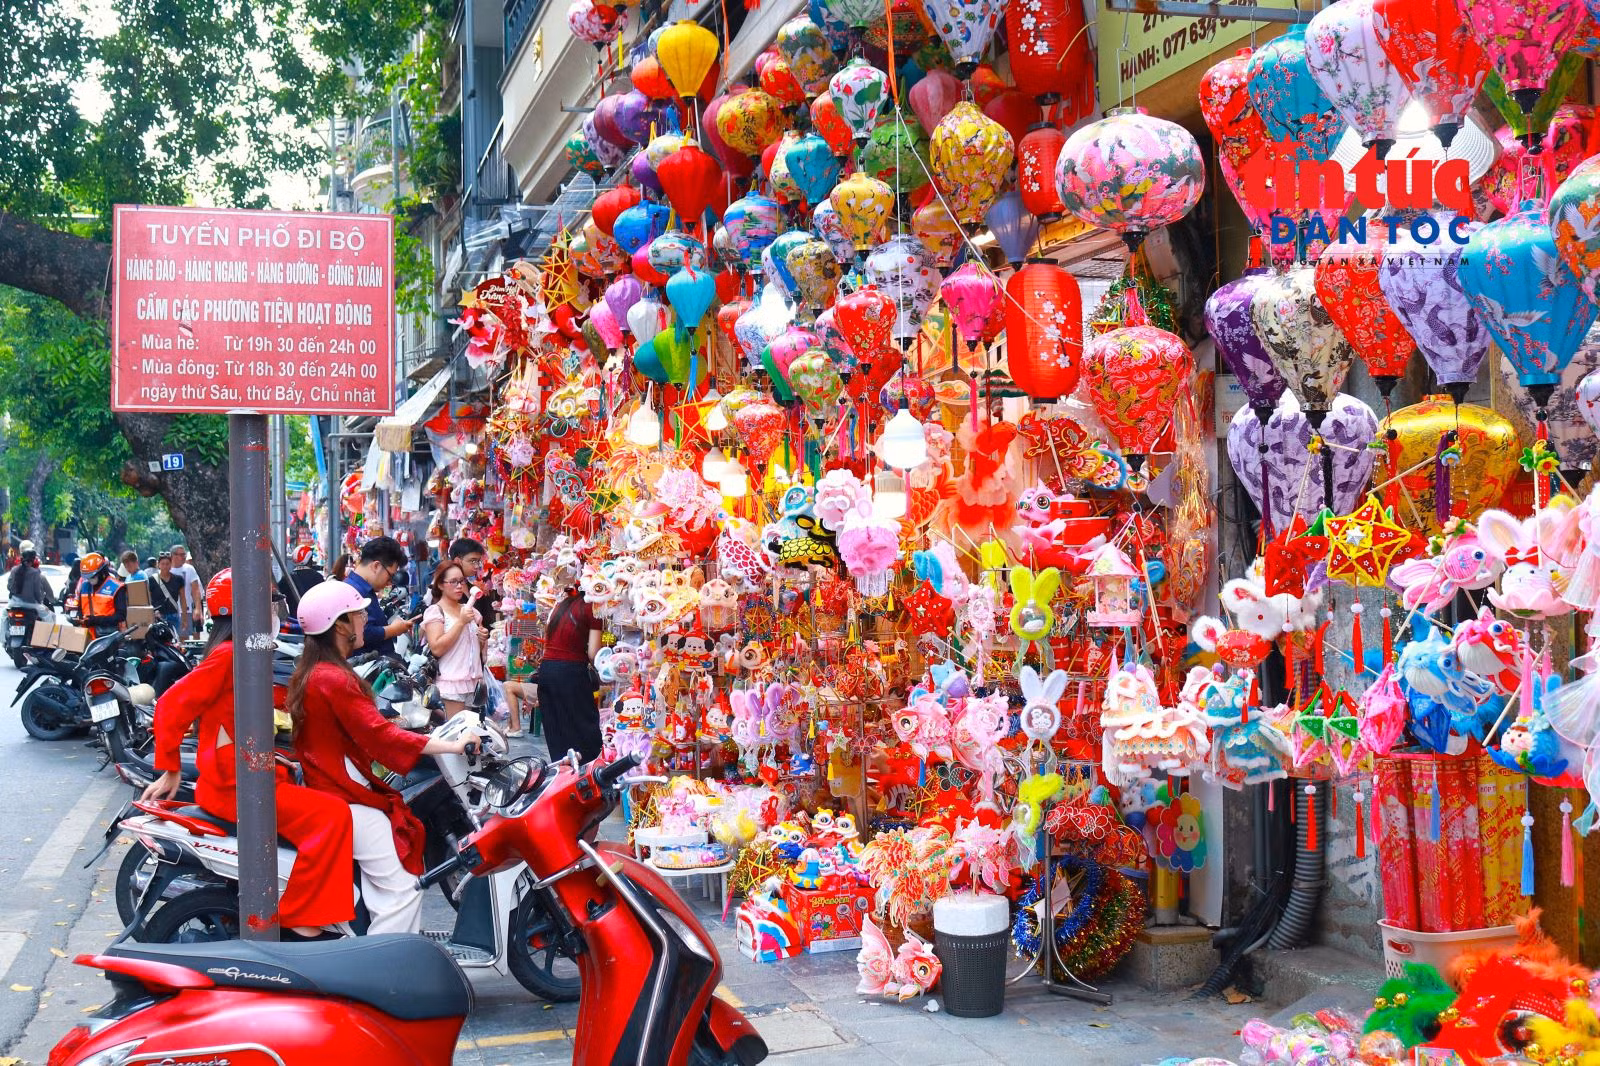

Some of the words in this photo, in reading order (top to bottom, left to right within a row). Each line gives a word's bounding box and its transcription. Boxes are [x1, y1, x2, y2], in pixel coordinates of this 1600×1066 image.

[146, 218, 229, 247] TUYẾN
[238, 221, 291, 249] PHỐ
[297, 228, 321, 249] ĐI
[329, 225, 365, 257] BỘ
[126, 253, 154, 281] HÀNG
[155, 255, 177, 281] ĐÀO
[184, 255, 212, 282] HÀNG
[214, 260, 248, 283] NGANG
[257, 257, 284, 284] HÀNG
[286, 257, 319, 285] ĐƯỜNG
[327, 258, 354, 287] ĐỒNG
[356, 261, 383, 288] XUÂN
[137, 291, 169, 321] CẤM
[172, 293, 200, 321] CÁC
[203, 298, 260, 323] PHƯƠNG
[263, 296, 293, 329] TIỆN
[297, 301, 332, 330] HOẠT
[335, 298, 372, 331] ĐỘNG
[142, 334, 173, 350] Mùa
[224, 335, 244, 351] Từ
[247, 336, 273, 352] 19h
[277, 337, 295, 352] 30
[298, 335, 325, 353] đến
[329, 338, 355, 354] 24h
[359, 339, 377, 354] 00
[142, 358, 173, 374] Mùa
[177, 358, 219, 379] đông:
[224, 360, 245, 376] Từ
[248, 361, 274, 376] 18h
[278, 361, 295, 377] 30
[299, 359, 326, 377] đến
[330, 362, 356, 378] 24h
[360, 363, 377, 379] 00
[141, 383, 177, 402] ngày
[181, 383, 208, 399] thứ
[210, 384, 242, 402] Sáu,
[247, 385, 272, 400] thứ
[275, 381, 306, 405] Bẩy,
[310, 383, 340, 401] Chủ
[344, 387, 376, 407] nhật
[167, 456, 180, 468] 19
[214, 966, 292, 984] Grande
